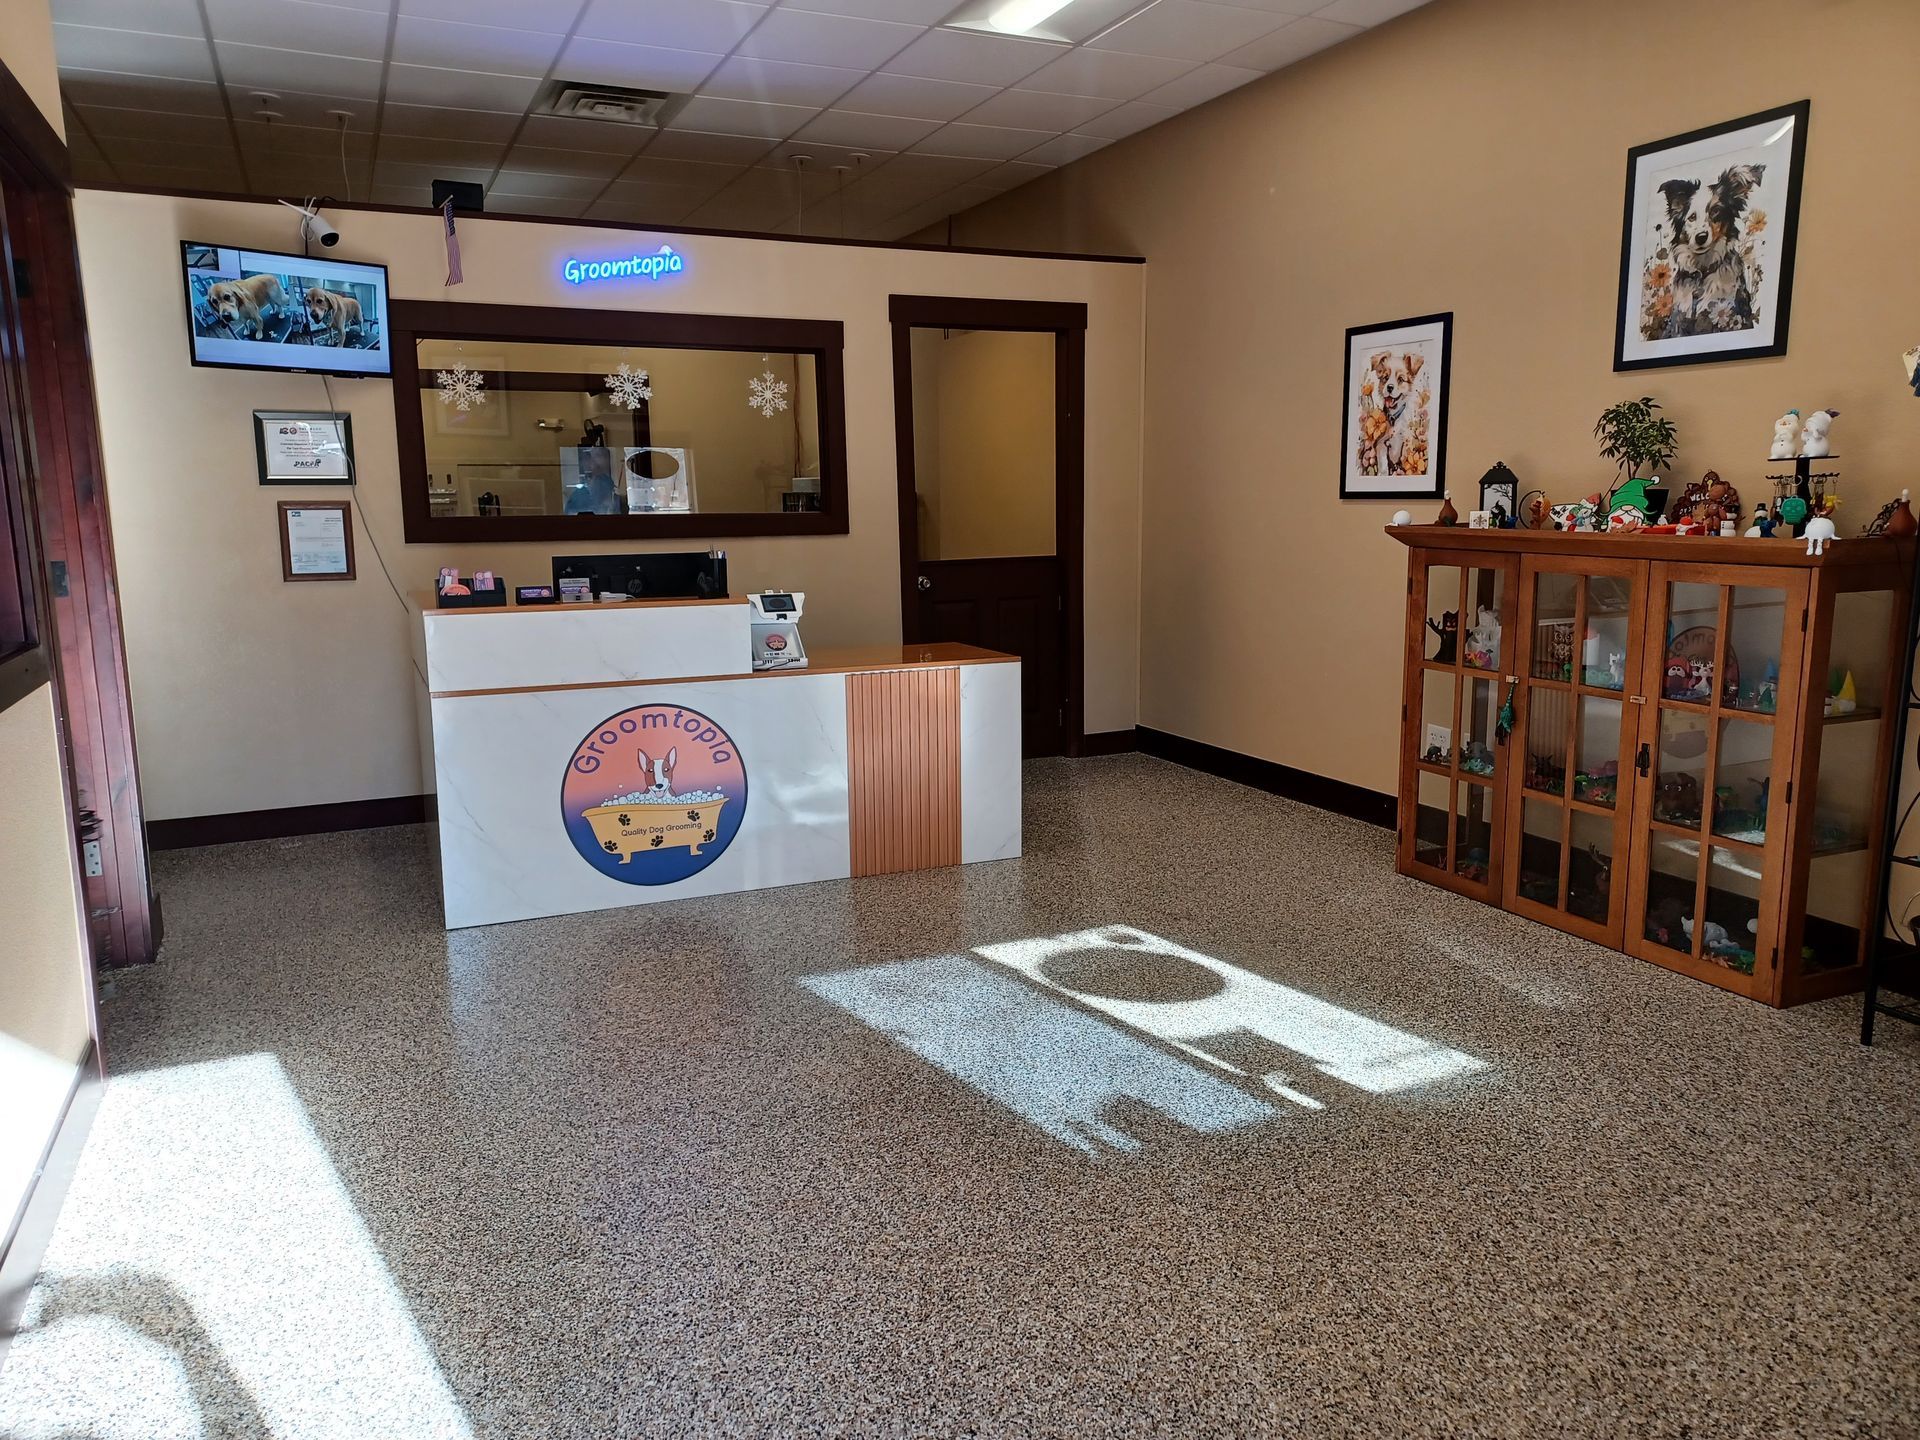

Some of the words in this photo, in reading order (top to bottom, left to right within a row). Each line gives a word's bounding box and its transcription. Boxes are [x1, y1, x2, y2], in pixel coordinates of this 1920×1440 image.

[565, 248, 682, 283] Groomtopia
[573, 710, 732, 774] Groomtopia
[621, 828, 648, 837] Quality
[649, 826, 664, 834] Dog
[666, 822, 702, 832] Grooming
